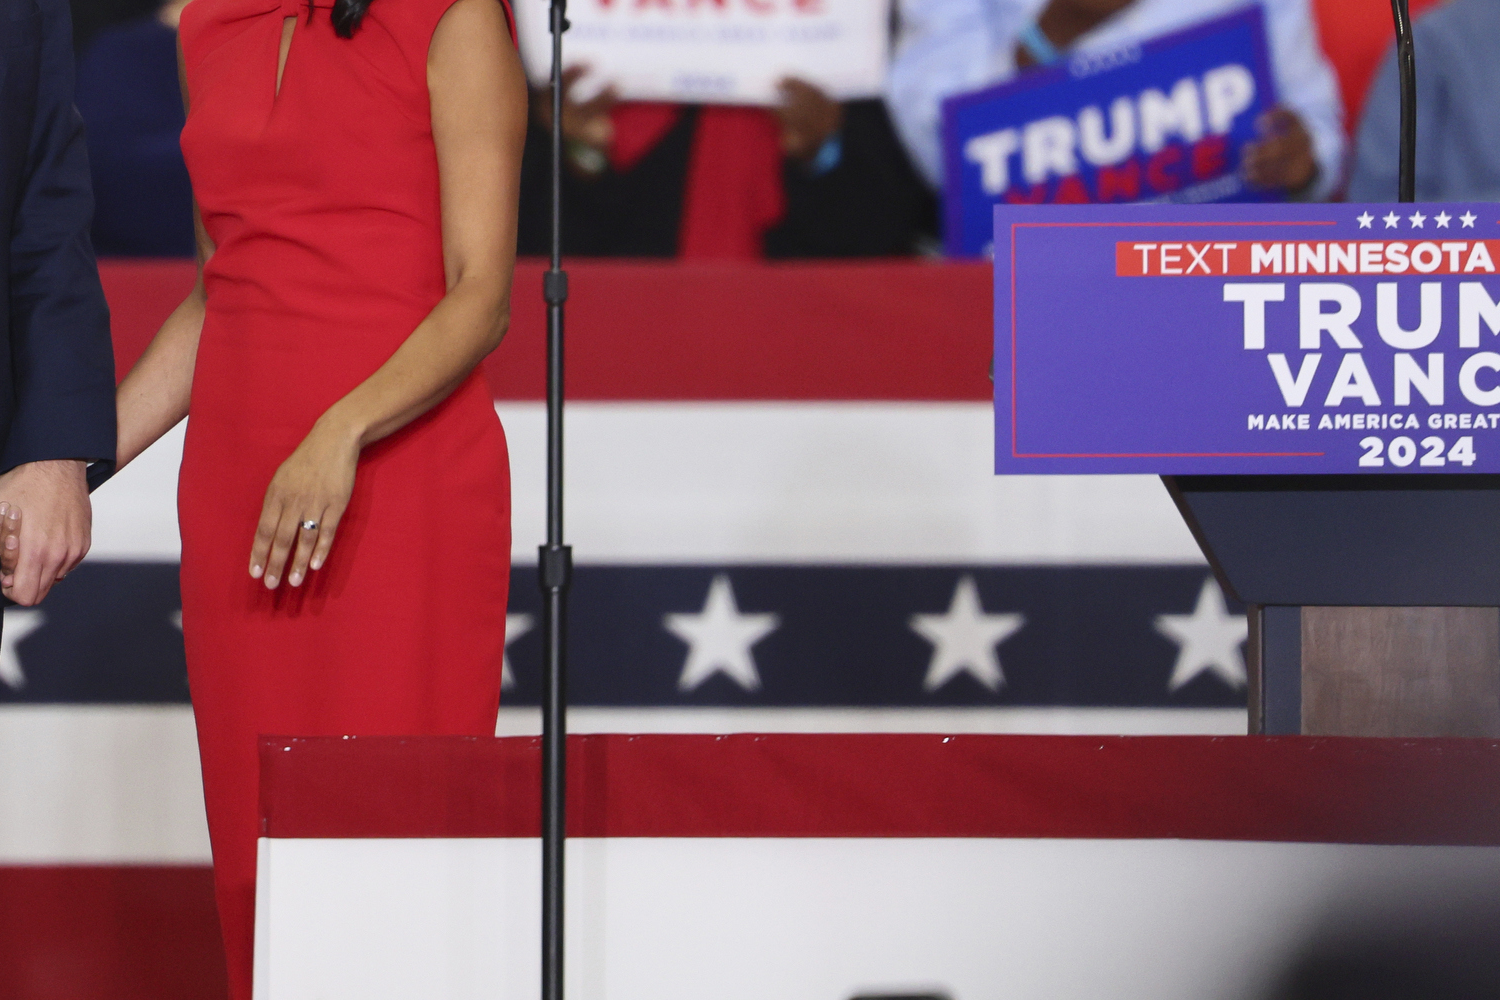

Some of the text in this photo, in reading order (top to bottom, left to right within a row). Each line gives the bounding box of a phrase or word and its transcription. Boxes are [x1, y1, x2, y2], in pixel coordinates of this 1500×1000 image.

[963, 64, 1257, 197] TRUMP
[1133, 241, 1496, 274] TEXT MINNESOTA
[1266, 352, 1500, 407] VANC
[1248, 413, 1500, 430] MAKE AMERICA GREAT
[1358, 435, 1477, 468] 2024
